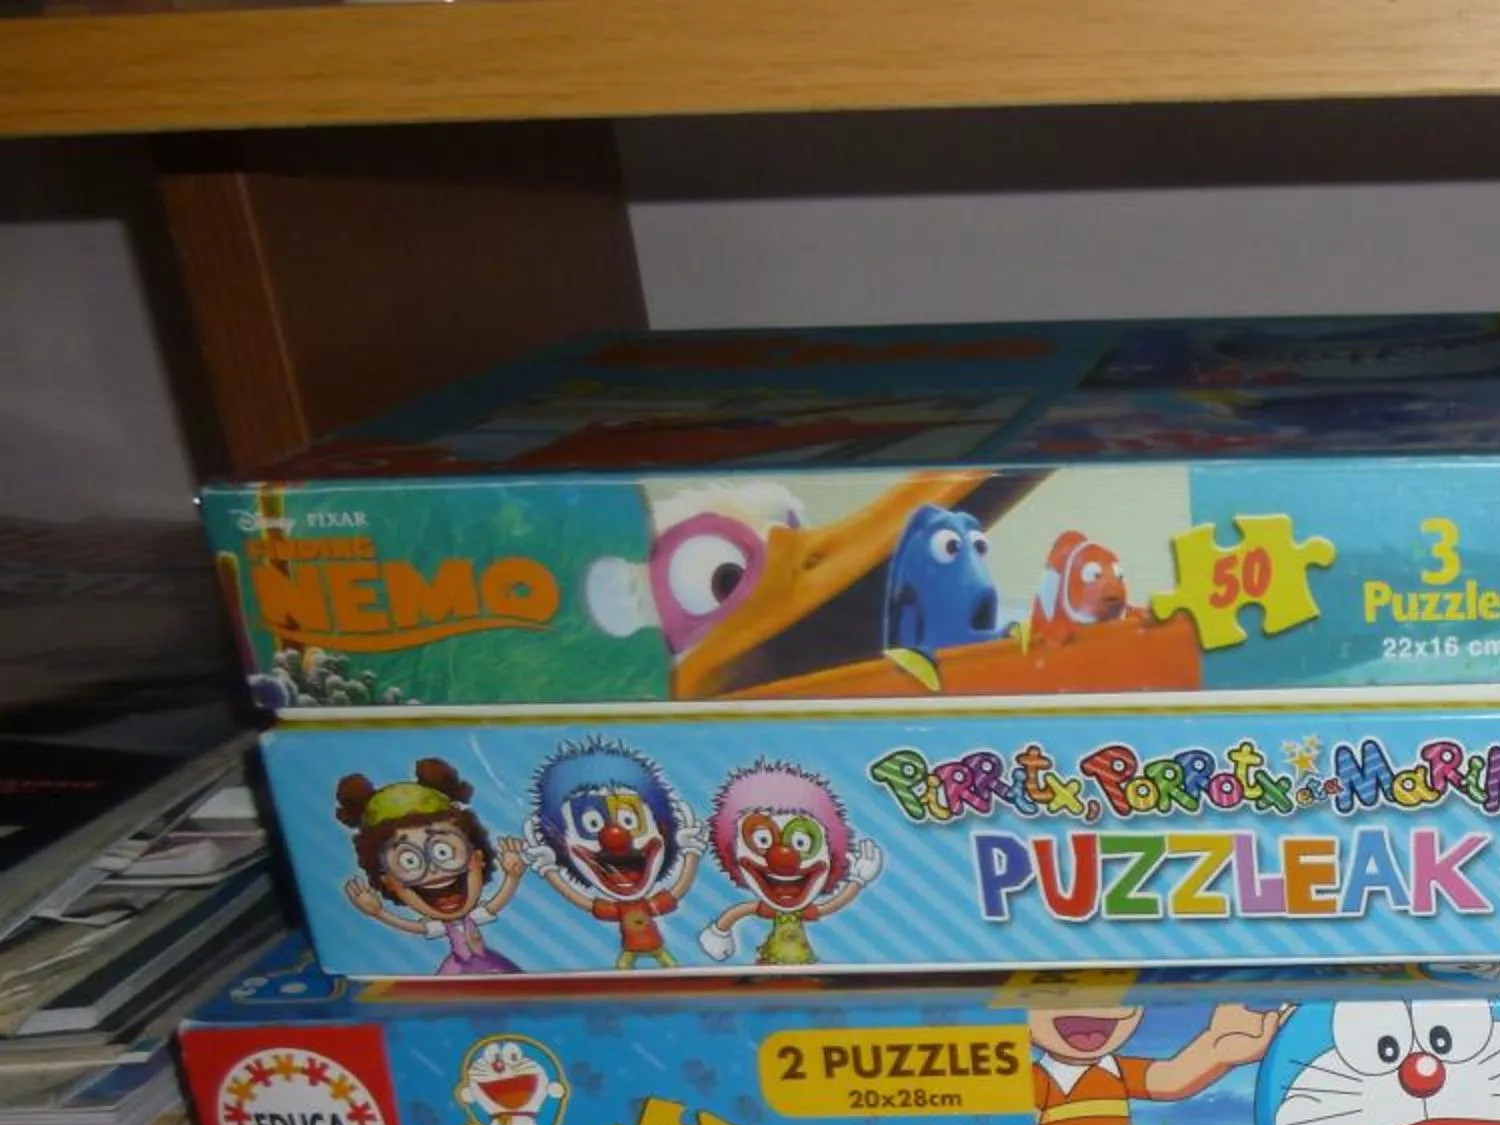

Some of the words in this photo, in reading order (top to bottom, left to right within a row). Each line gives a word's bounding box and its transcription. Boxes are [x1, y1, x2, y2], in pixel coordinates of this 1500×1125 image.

[305, 511, 368, 528] PIXAR
[1420, 518, 1460, 584] 3
[251, 557, 560, 634] NEMO
[1208, 547, 1272, 607] 50
[1381, 636, 1460, 660] 22x16
[972, 828, 1494, 921] PUZZLEAK
[777, 1045, 807, 1081] 2
[822, 1041, 1020, 1080] PUZZLES
[848, 1089, 963, 1109] 20x28cm
